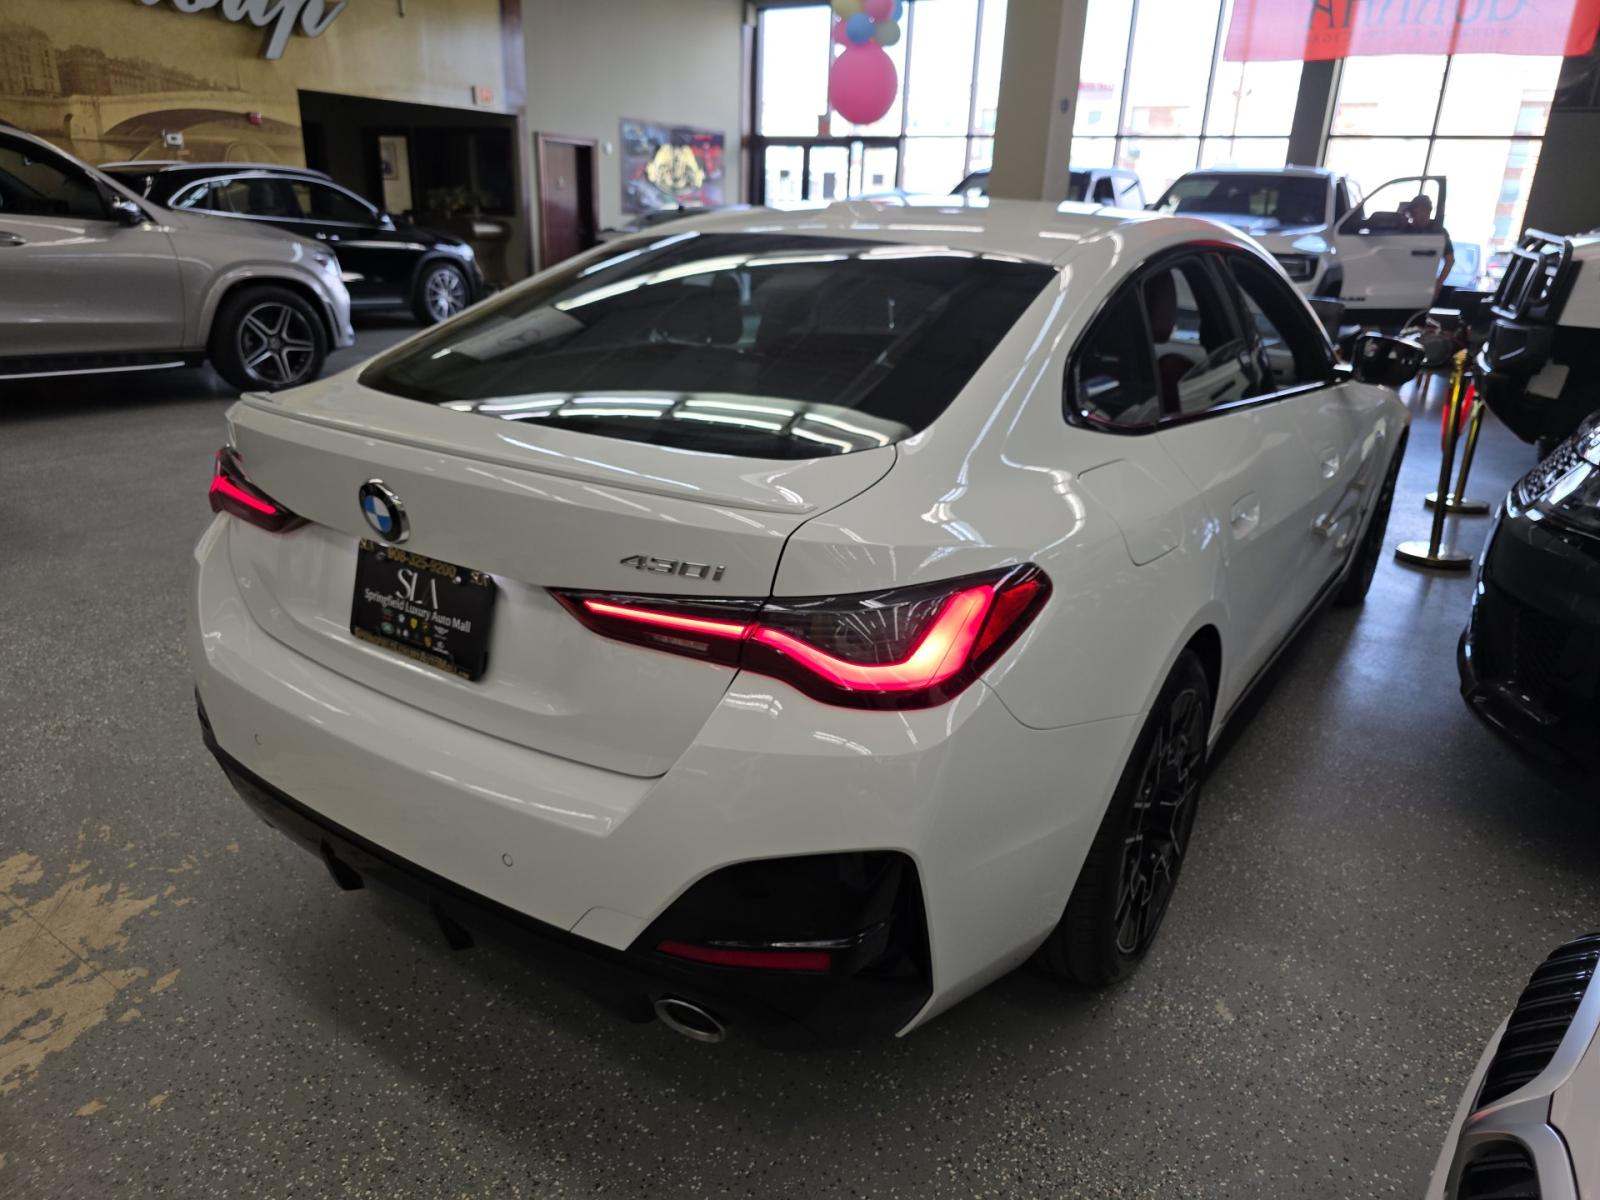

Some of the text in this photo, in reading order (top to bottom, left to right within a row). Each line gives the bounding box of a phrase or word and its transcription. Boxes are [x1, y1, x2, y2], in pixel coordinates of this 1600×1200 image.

[619, 554, 726, 581] 430i
[395, 568, 439, 609] SLA
[364, 588, 405, 611] Springfield
[405, 602, 431, 620] Luxury
[431, 610, 451, 626] Auto
[452, 617, 472, 633] Mall
